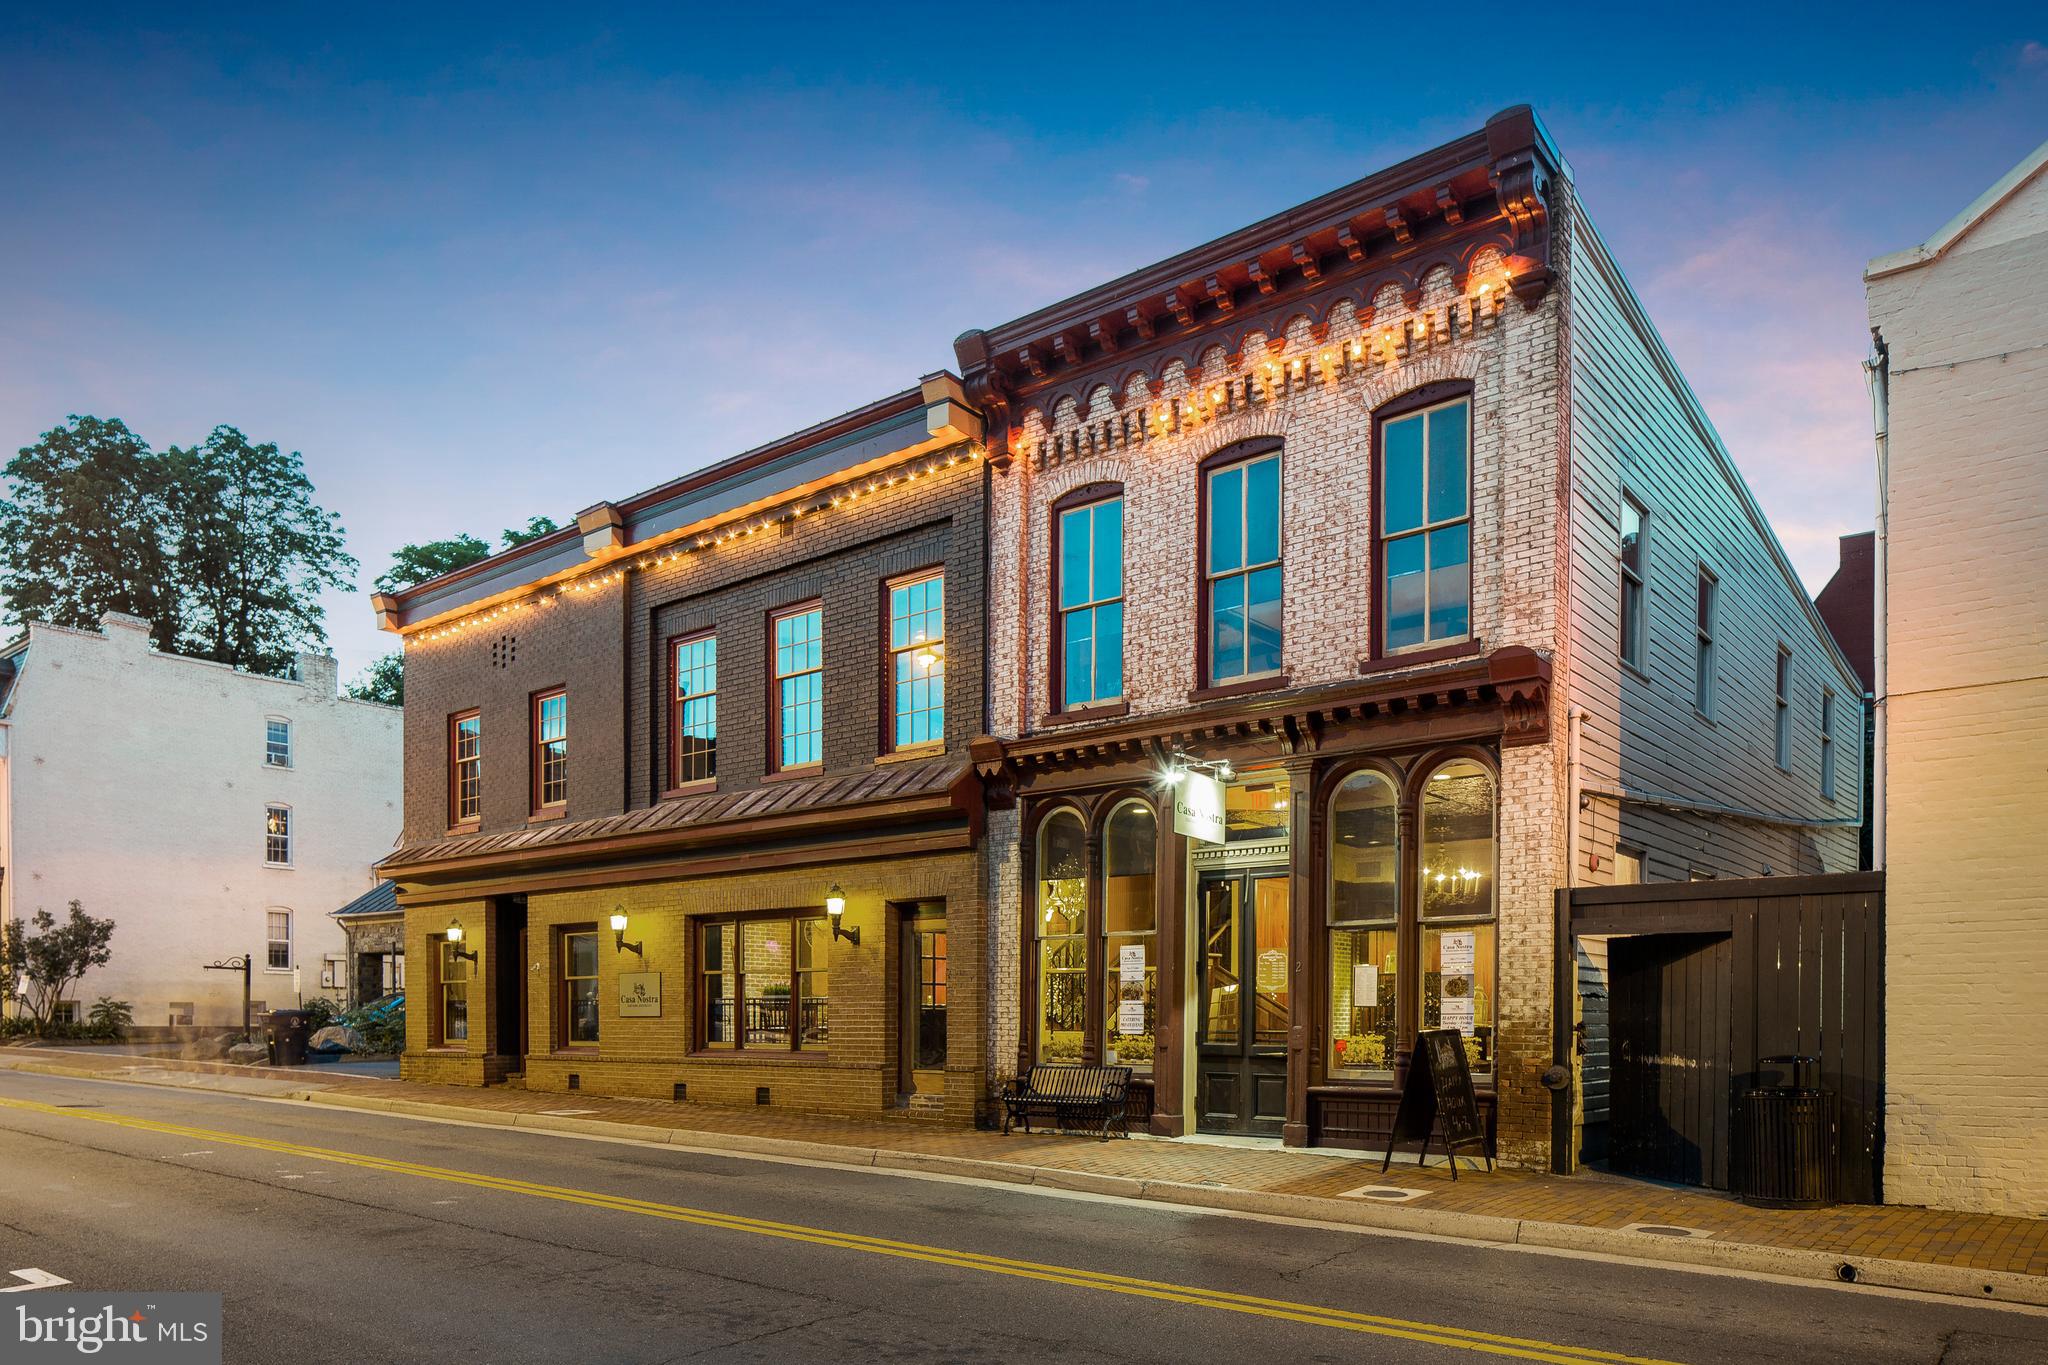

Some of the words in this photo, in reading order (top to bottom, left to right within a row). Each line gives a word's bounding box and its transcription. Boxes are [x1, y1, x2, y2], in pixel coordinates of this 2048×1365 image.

[1177, 801, 1196, 817] Casa
[1296, 961, 1302, 973] 2
[620, 994, 636, 1004] Casa
[637, 994, 659, 1004] Nostra
